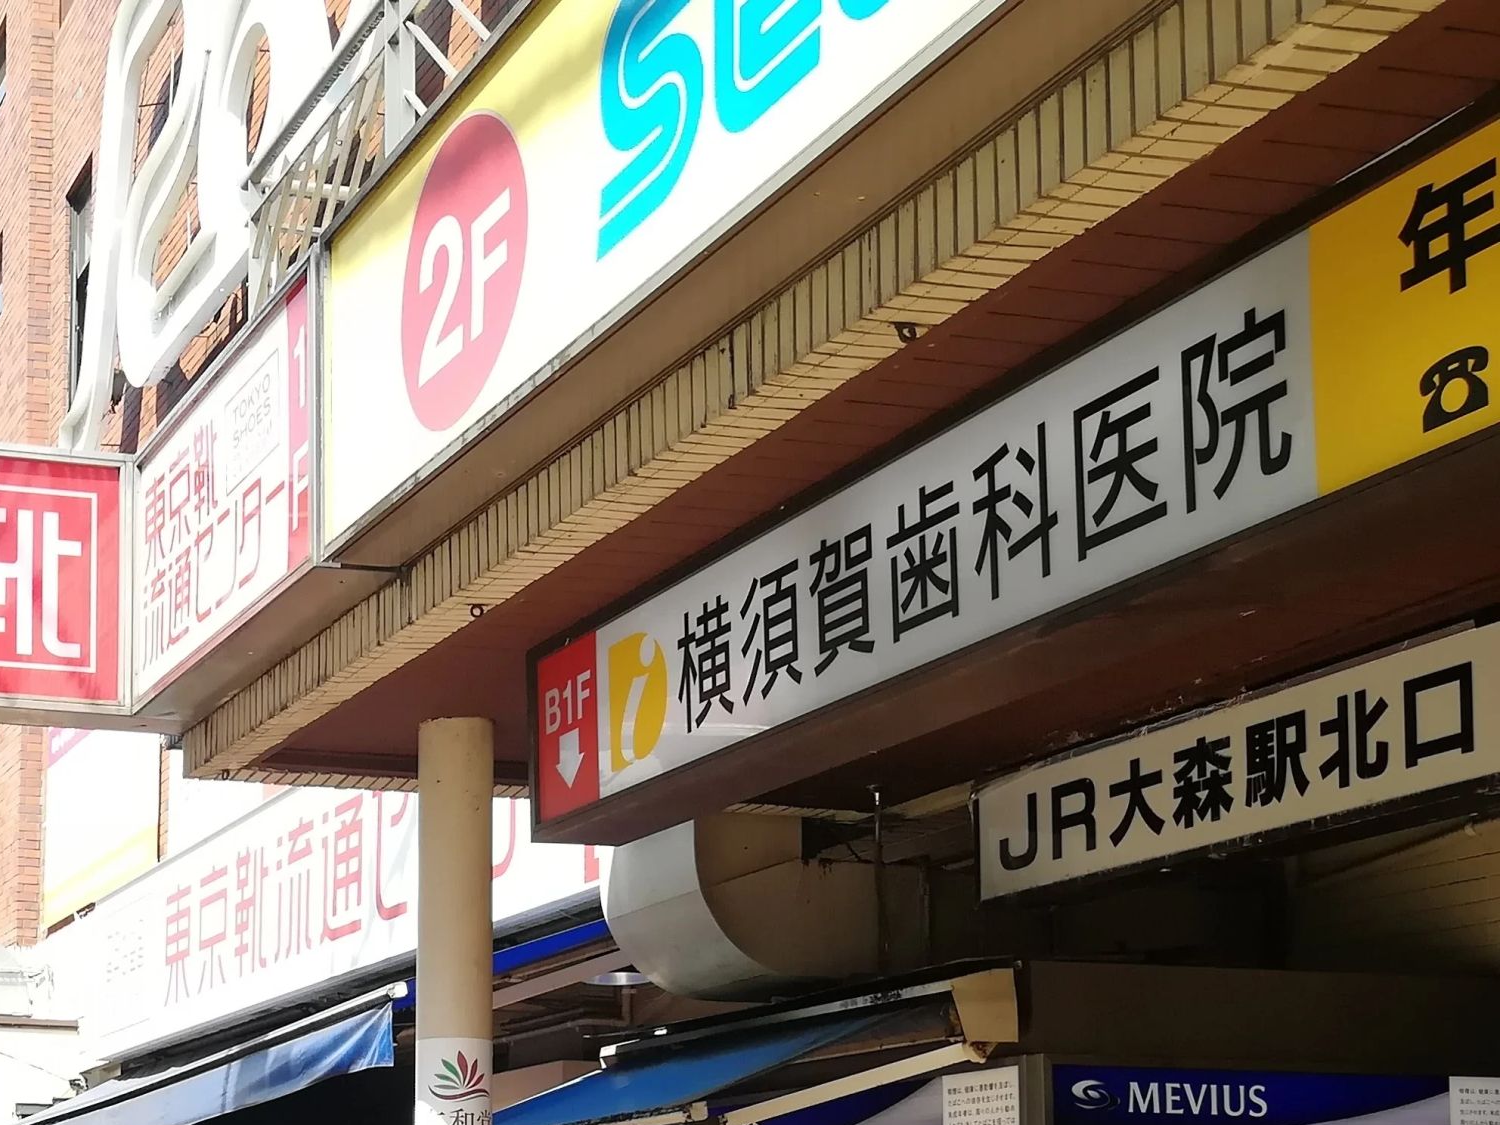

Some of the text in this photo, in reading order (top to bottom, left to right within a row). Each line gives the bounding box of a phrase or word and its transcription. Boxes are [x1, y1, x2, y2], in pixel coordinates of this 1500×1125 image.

[597, 0, 892, 262] SE
[1397, 157, 1500, 295] 年
[418, 188, 512, 390] 2F
[142, 478, 286, 672] 流通センター
[145, 418, 220, 580] 東京靴
[675, 306, 1294, 734] 横須賀歯科医院
[543, 668, 594, 736] B1F
[998, 661, 1476, 875] JR大森駅北口
[164, 790, 516, 1008] 東京靴流通セ
[1128, 1081, 1269, 1118] MEVIUS
